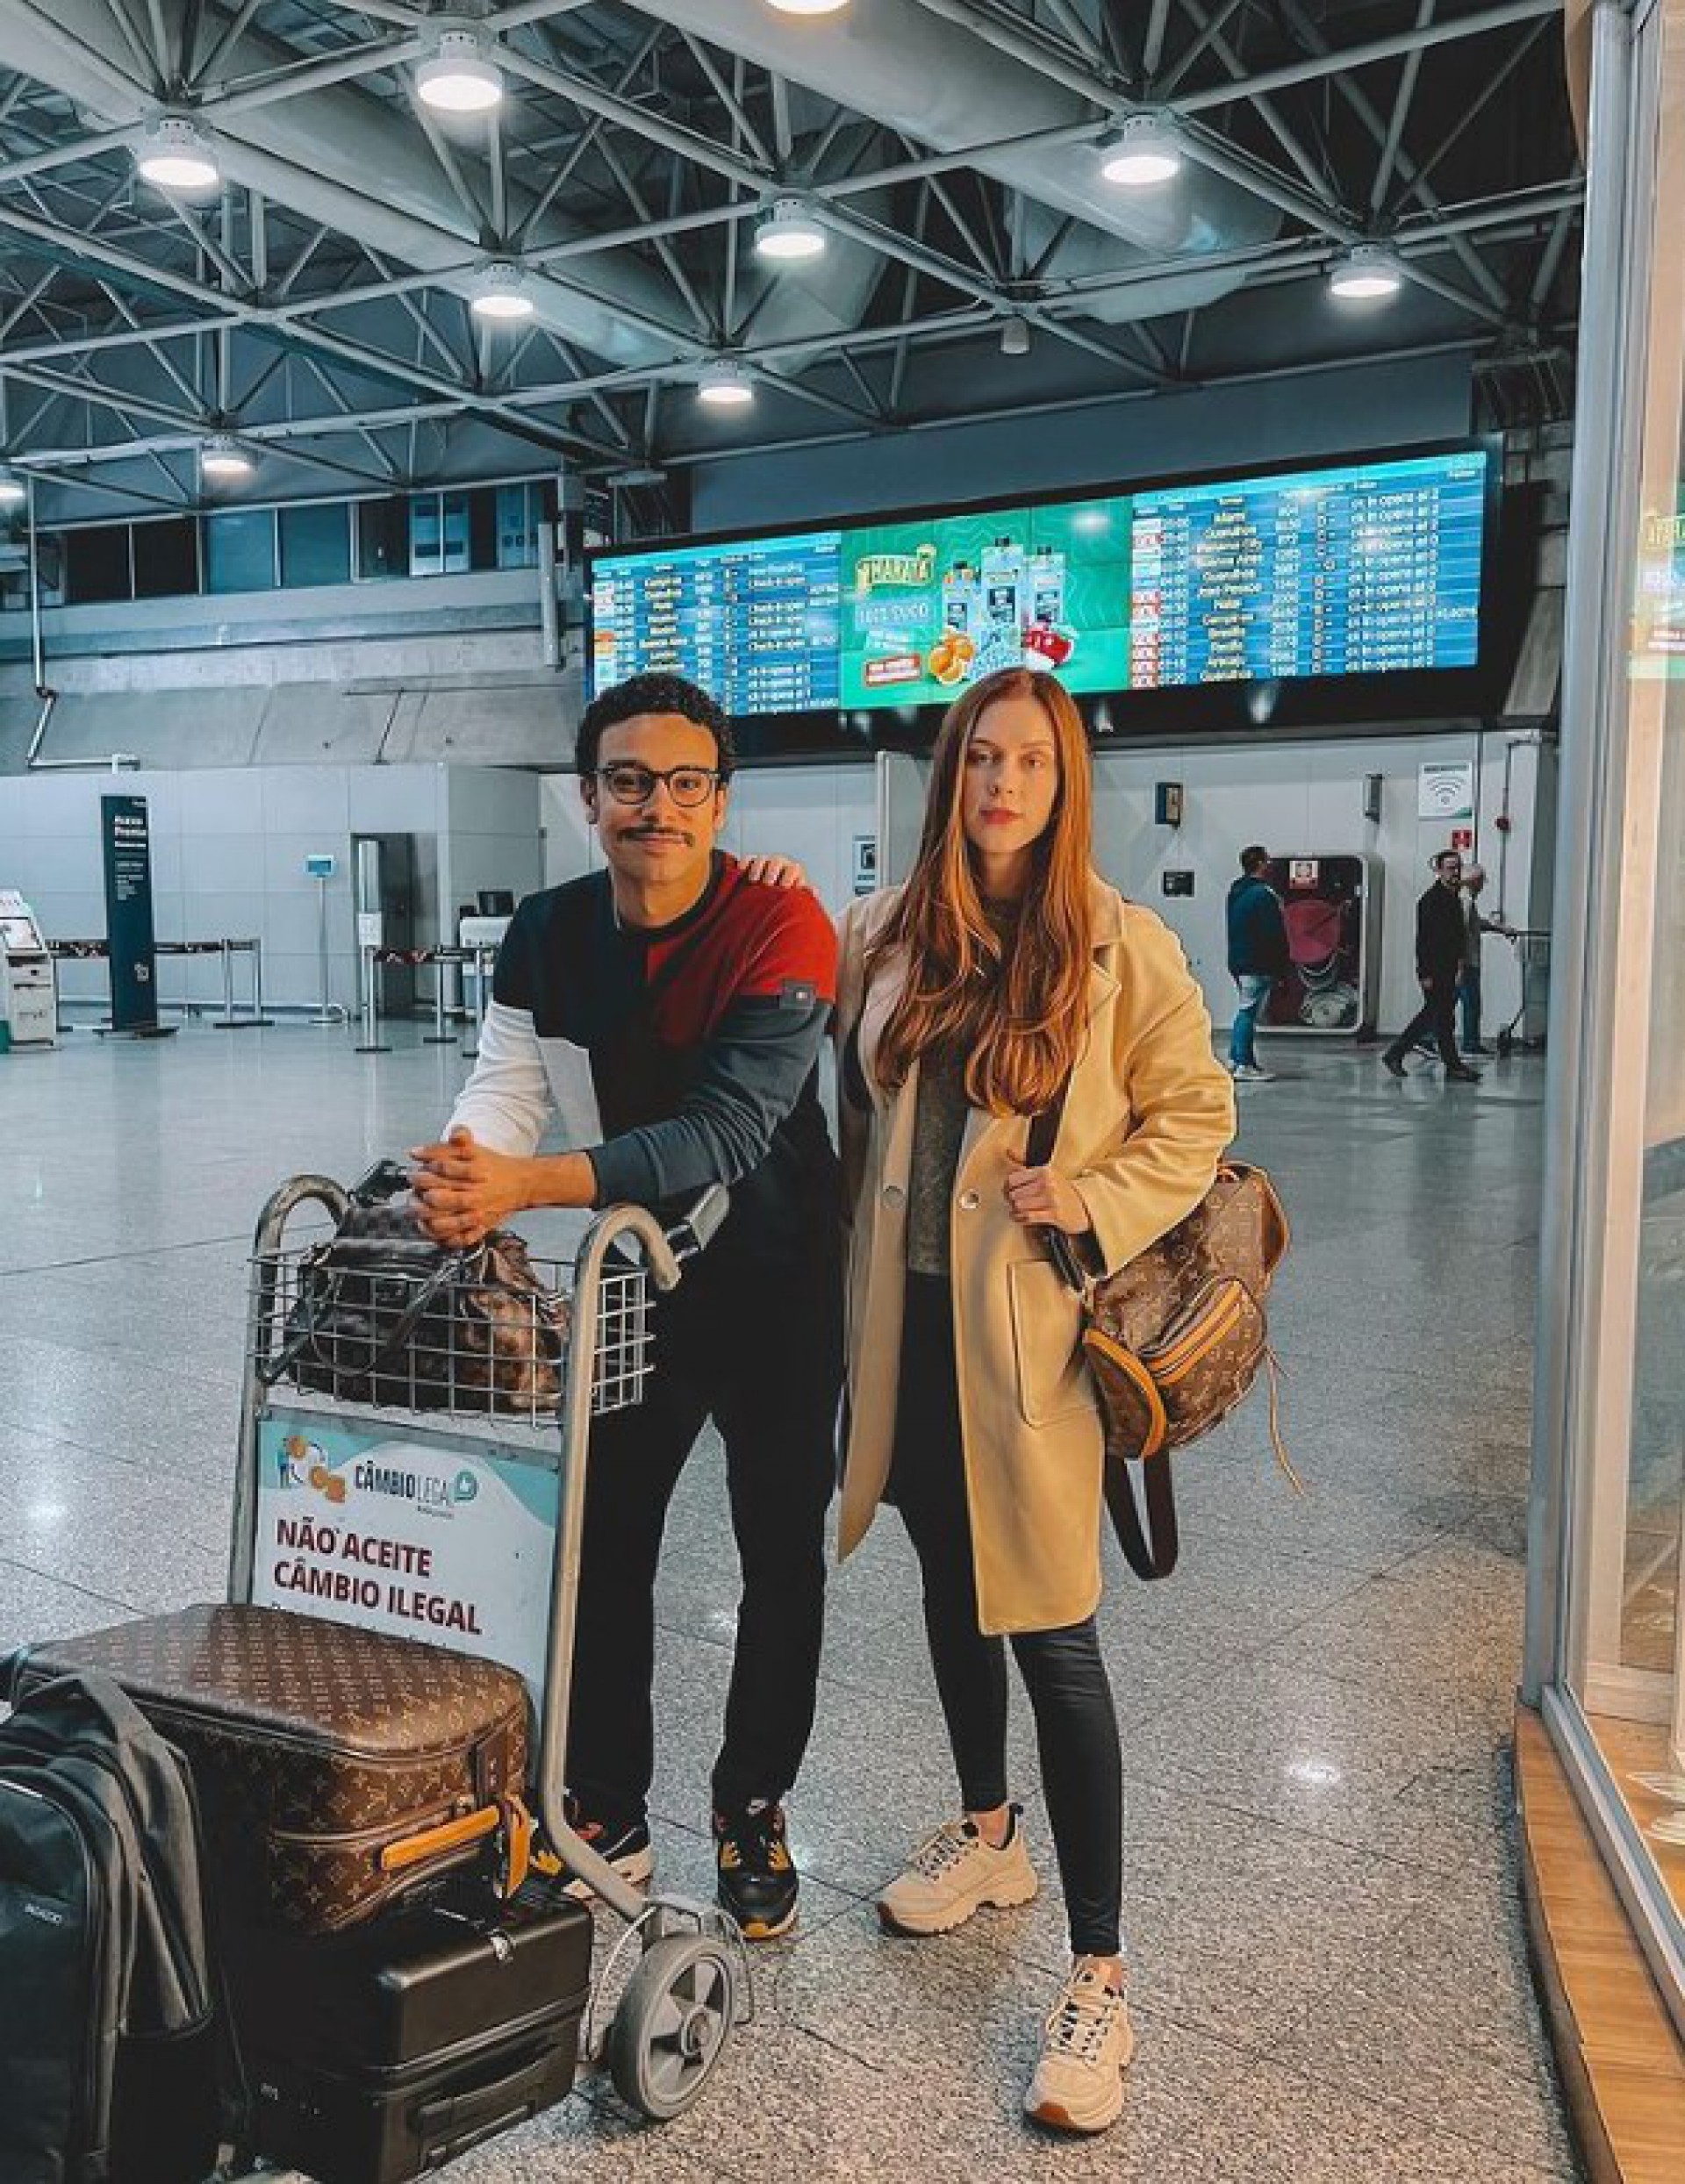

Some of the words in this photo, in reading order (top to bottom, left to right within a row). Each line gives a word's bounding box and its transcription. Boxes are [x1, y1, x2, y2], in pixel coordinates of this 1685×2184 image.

[276, 1516, 335, 1554] NÃO
[341, 1533, 433, 1578] ACEITE
[274, 1556, 379, 1609] CÂMBIO
[386, 1586, 483, 1636] ILEGAL
